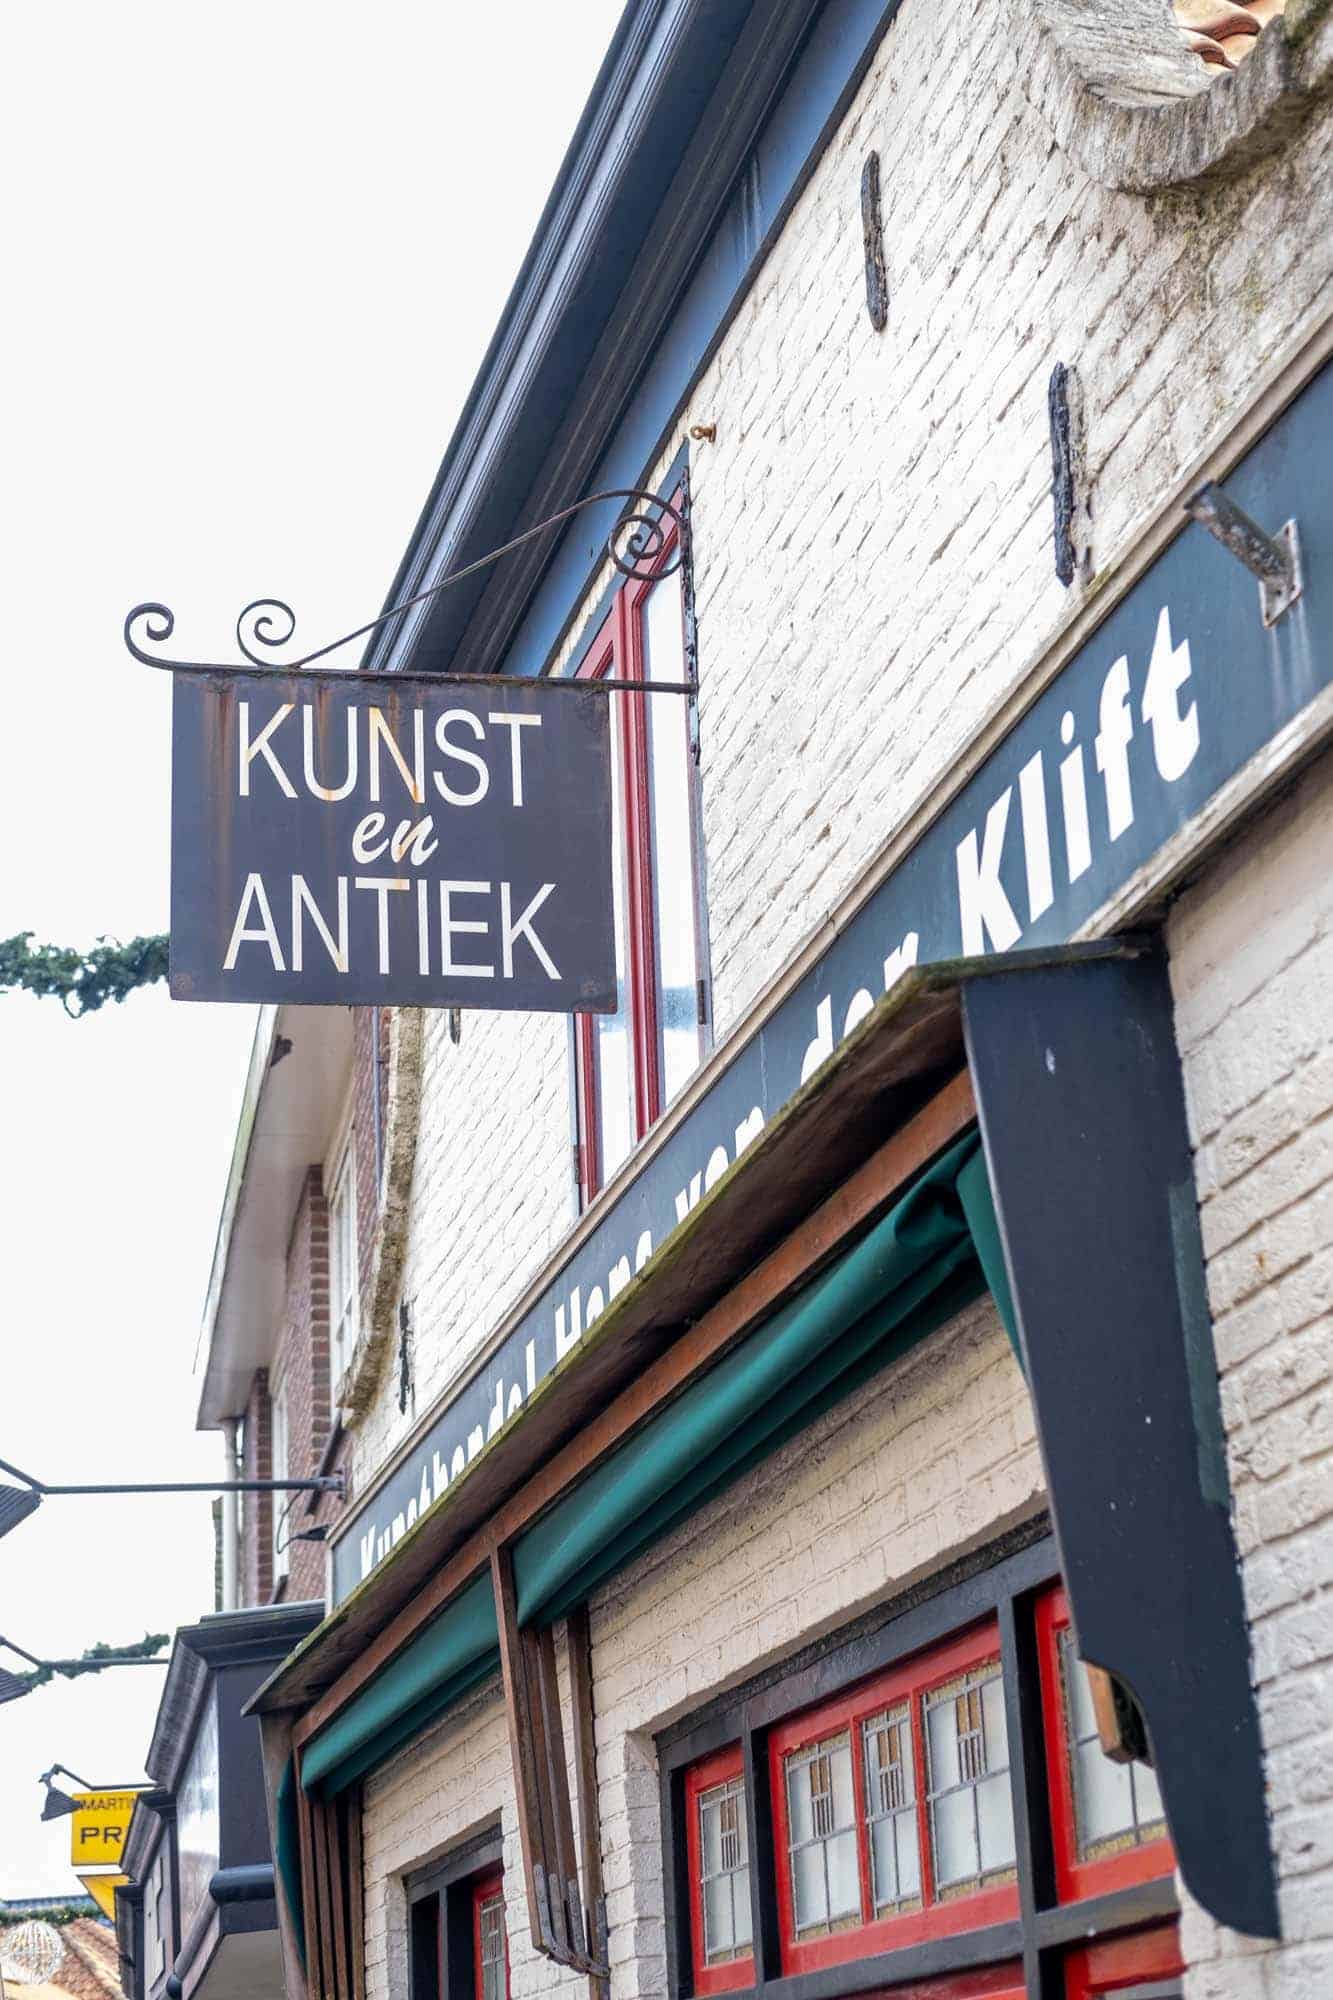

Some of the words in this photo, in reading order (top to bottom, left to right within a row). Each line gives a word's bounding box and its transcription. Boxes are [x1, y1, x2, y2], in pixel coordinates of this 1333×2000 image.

[238, 701, 542, 807] KUNST
[955, 604, 1200, 958] Klift
[351, 811, 439, 866] en
[222, 872, 563, 981] ANTIEK
